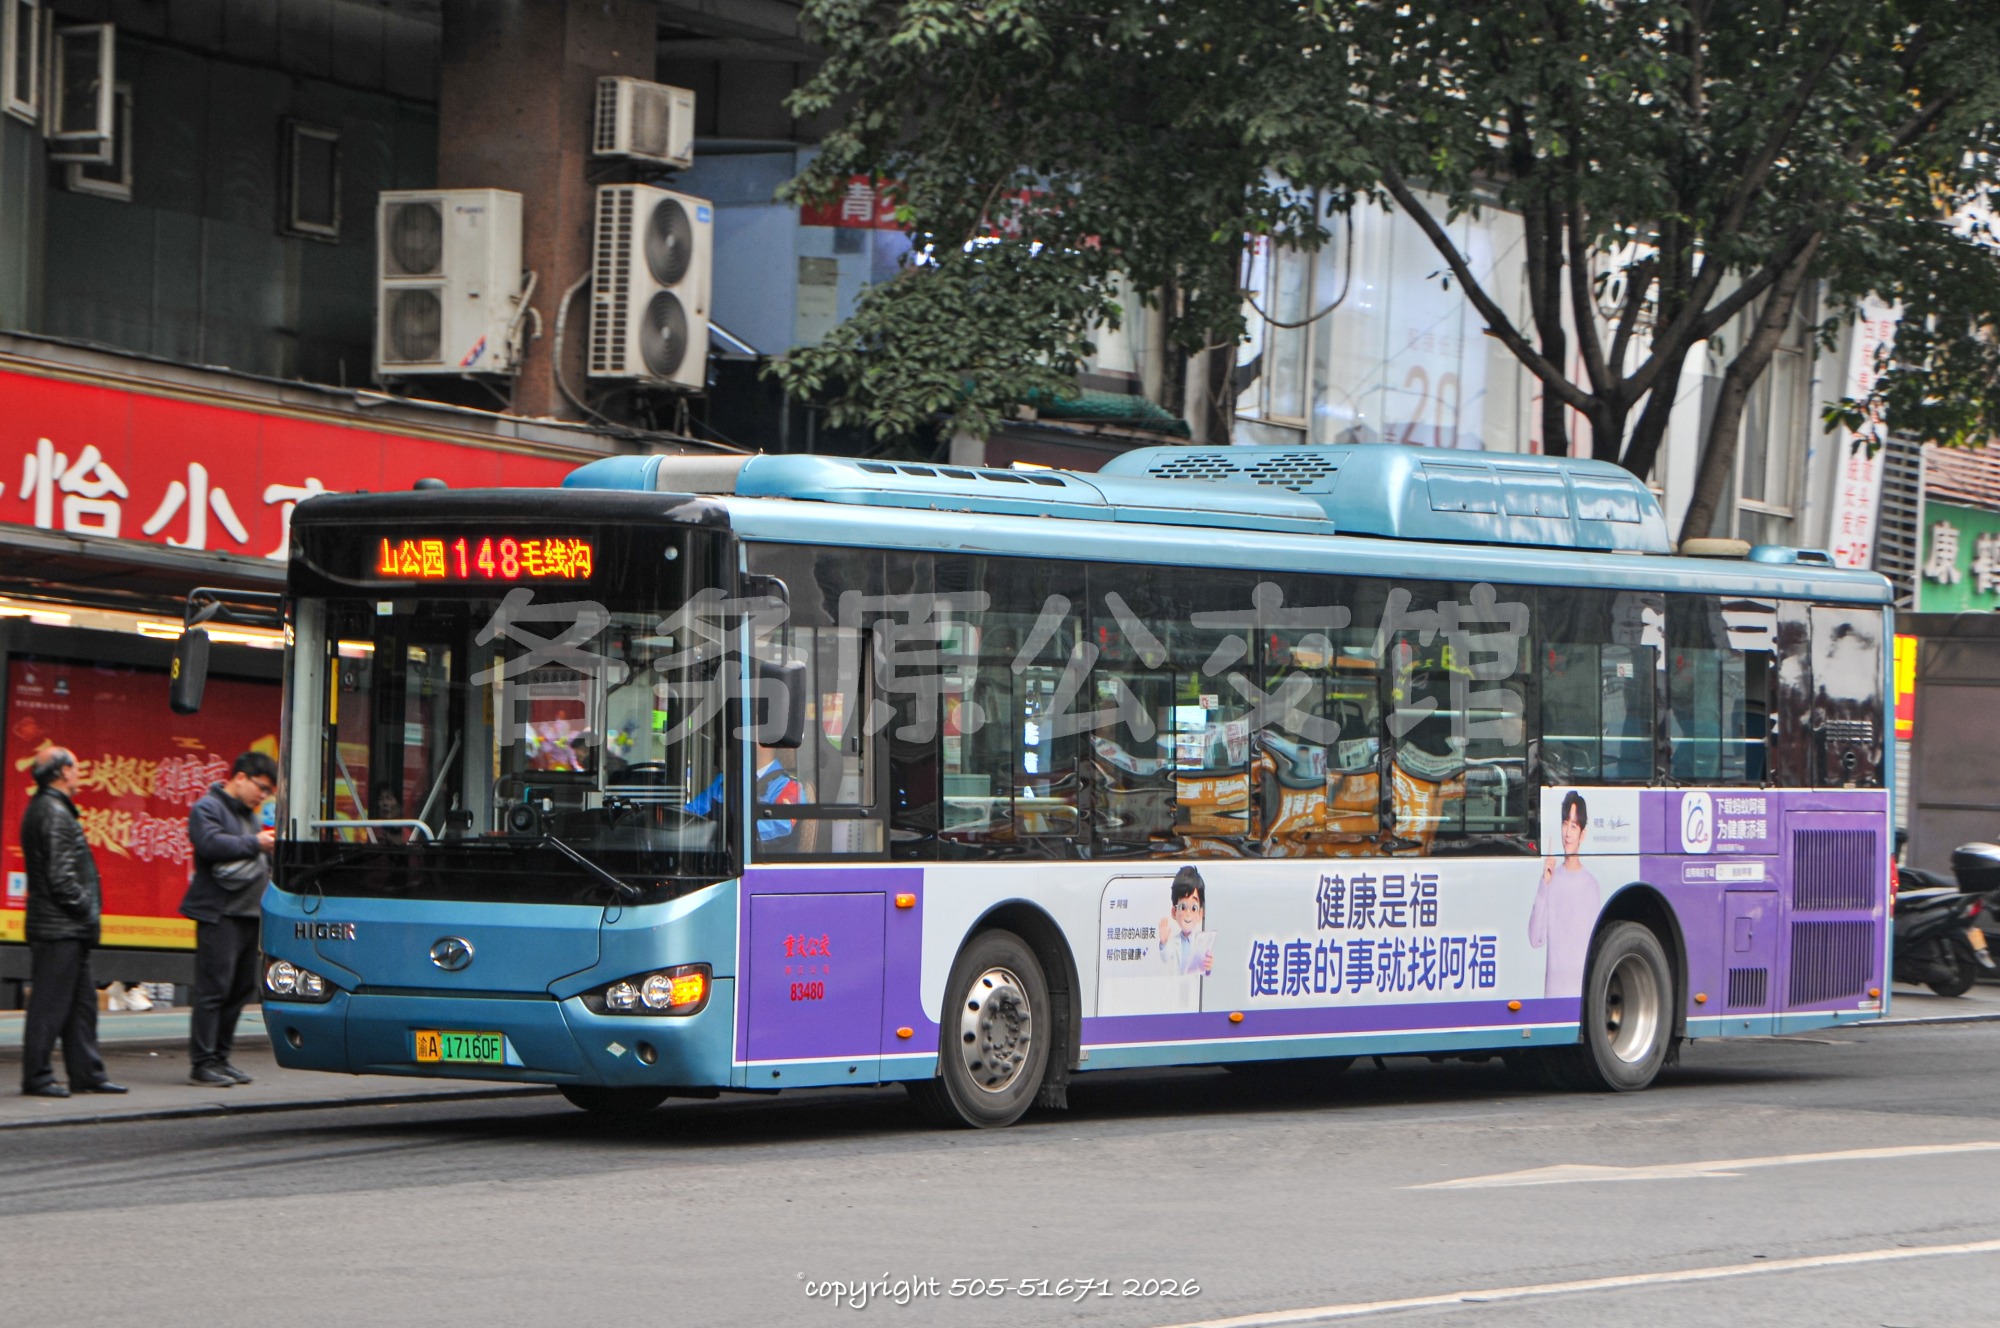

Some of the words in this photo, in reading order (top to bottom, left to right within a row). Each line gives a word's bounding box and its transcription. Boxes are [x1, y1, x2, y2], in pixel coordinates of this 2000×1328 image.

[455, 537, 520, 579] 148
[520, 538, 592, 578] 毛线沟
[1717, 819, 1767, 839] 为健康添福
[1315, 872, 1439, 930] 健康是福
[294, 922, 356, 940] HIGER
[1107, 926, 1156, 940] 我是你的AI朋友
[783, 933, 831, 958] 重庆公交
[1106, 947, 1142, 961] 帮你管健康
[1248, 934, 1498, 998] 健康的事就找阿福
[790, 981, 824, 1001] 83480
[417, 1034, 438, 1058] 渝A
[445, 1036, 499, 1060] 17160F
